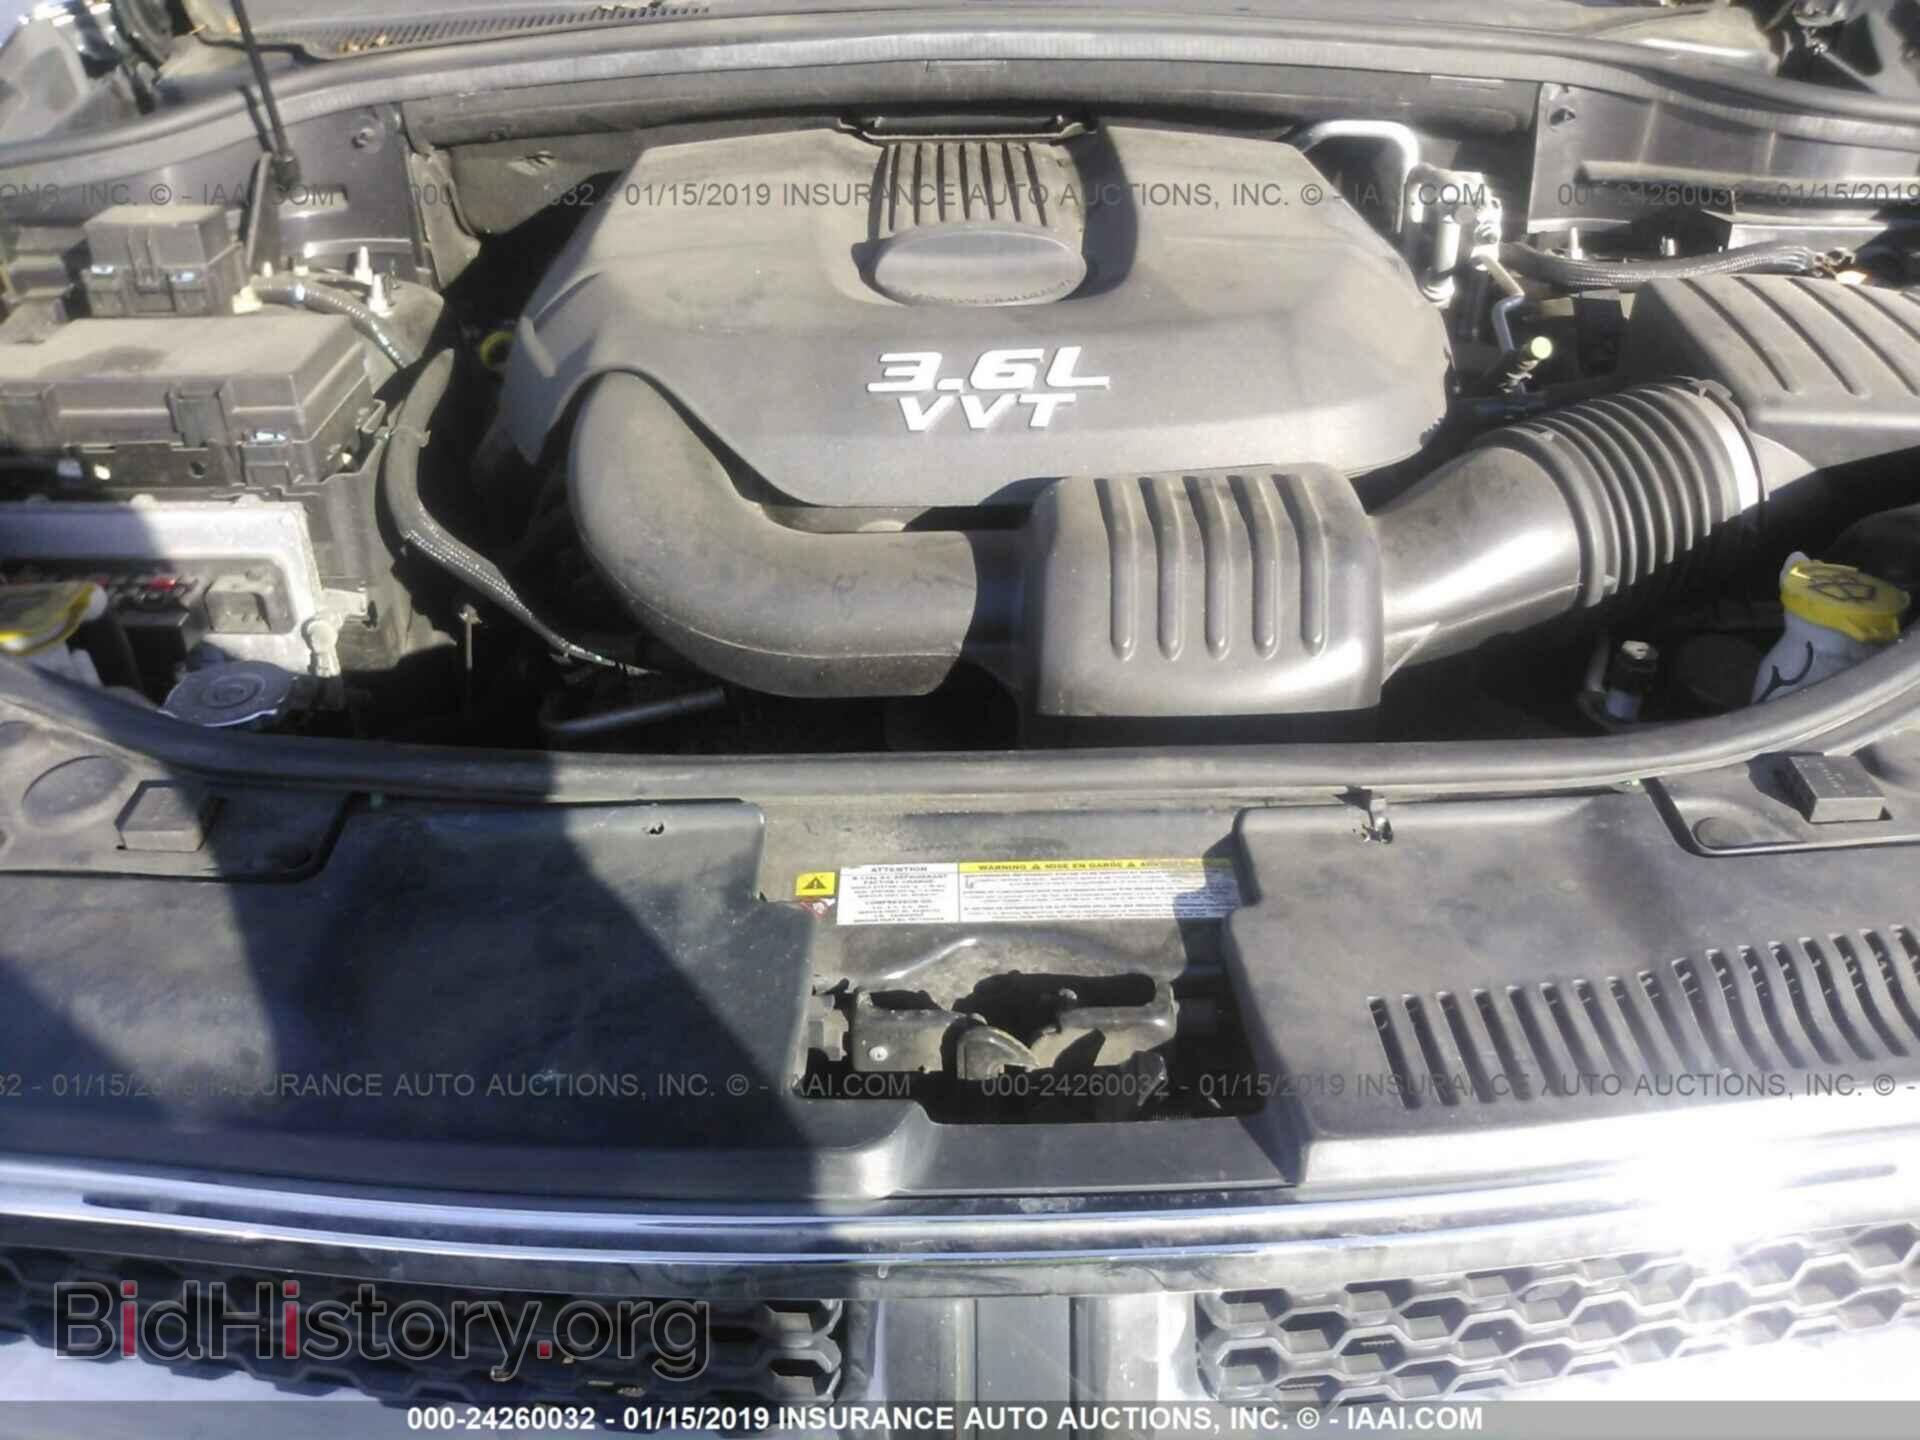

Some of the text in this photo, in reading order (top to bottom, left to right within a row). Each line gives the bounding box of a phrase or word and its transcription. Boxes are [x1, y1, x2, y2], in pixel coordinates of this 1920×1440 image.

[867, 346, 1111, 393] 3.6L
[899, 393, 1078, 431] VVT
[978, 863, 1027, 871] WARNING
